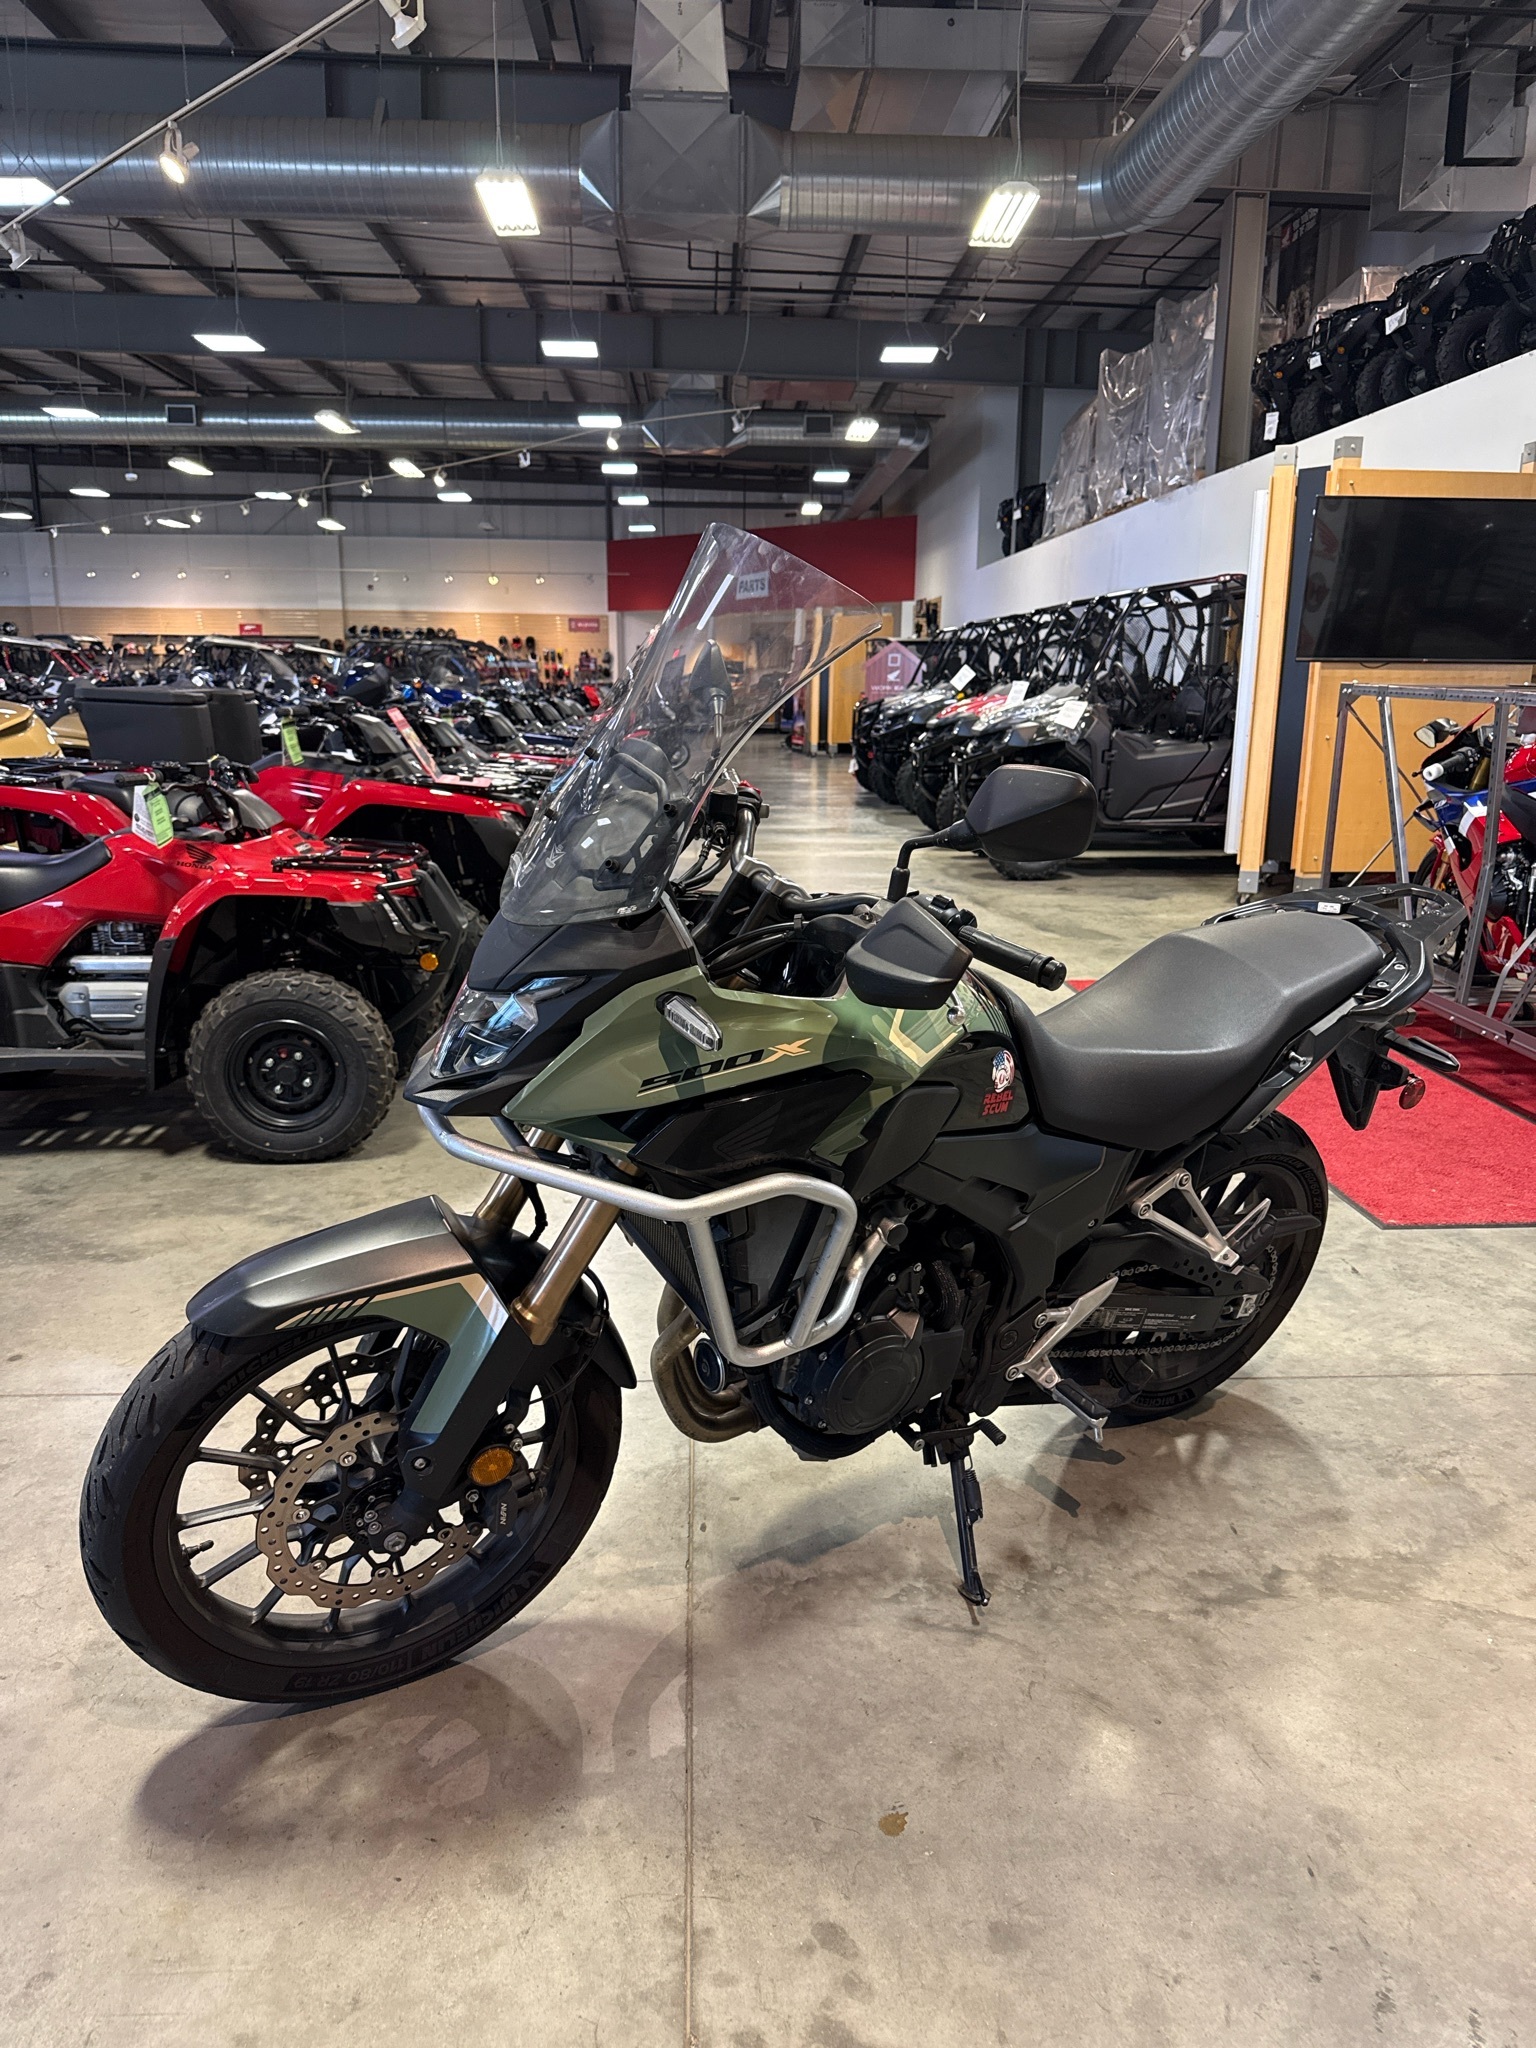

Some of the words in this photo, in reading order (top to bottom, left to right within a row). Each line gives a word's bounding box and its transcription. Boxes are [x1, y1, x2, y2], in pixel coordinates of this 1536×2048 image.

[738, 578, 766, 593] PARTS
[176, 860, 214, 871] HONDA
[637, 1037, 813, 1092] 500X
[983, 1090, 1014, 1104] REBEL
[982, 1101, 1010, 1116] SCUM
[217, 1321, 337, 1399] MICHELIN
[421, 1586, 520, 1660] MICHELIN
[347, 1658, 404, 1683] 110/80
[293, 1675, 314, 1690] 19
[316, 1672, 342, 1688] ZR
